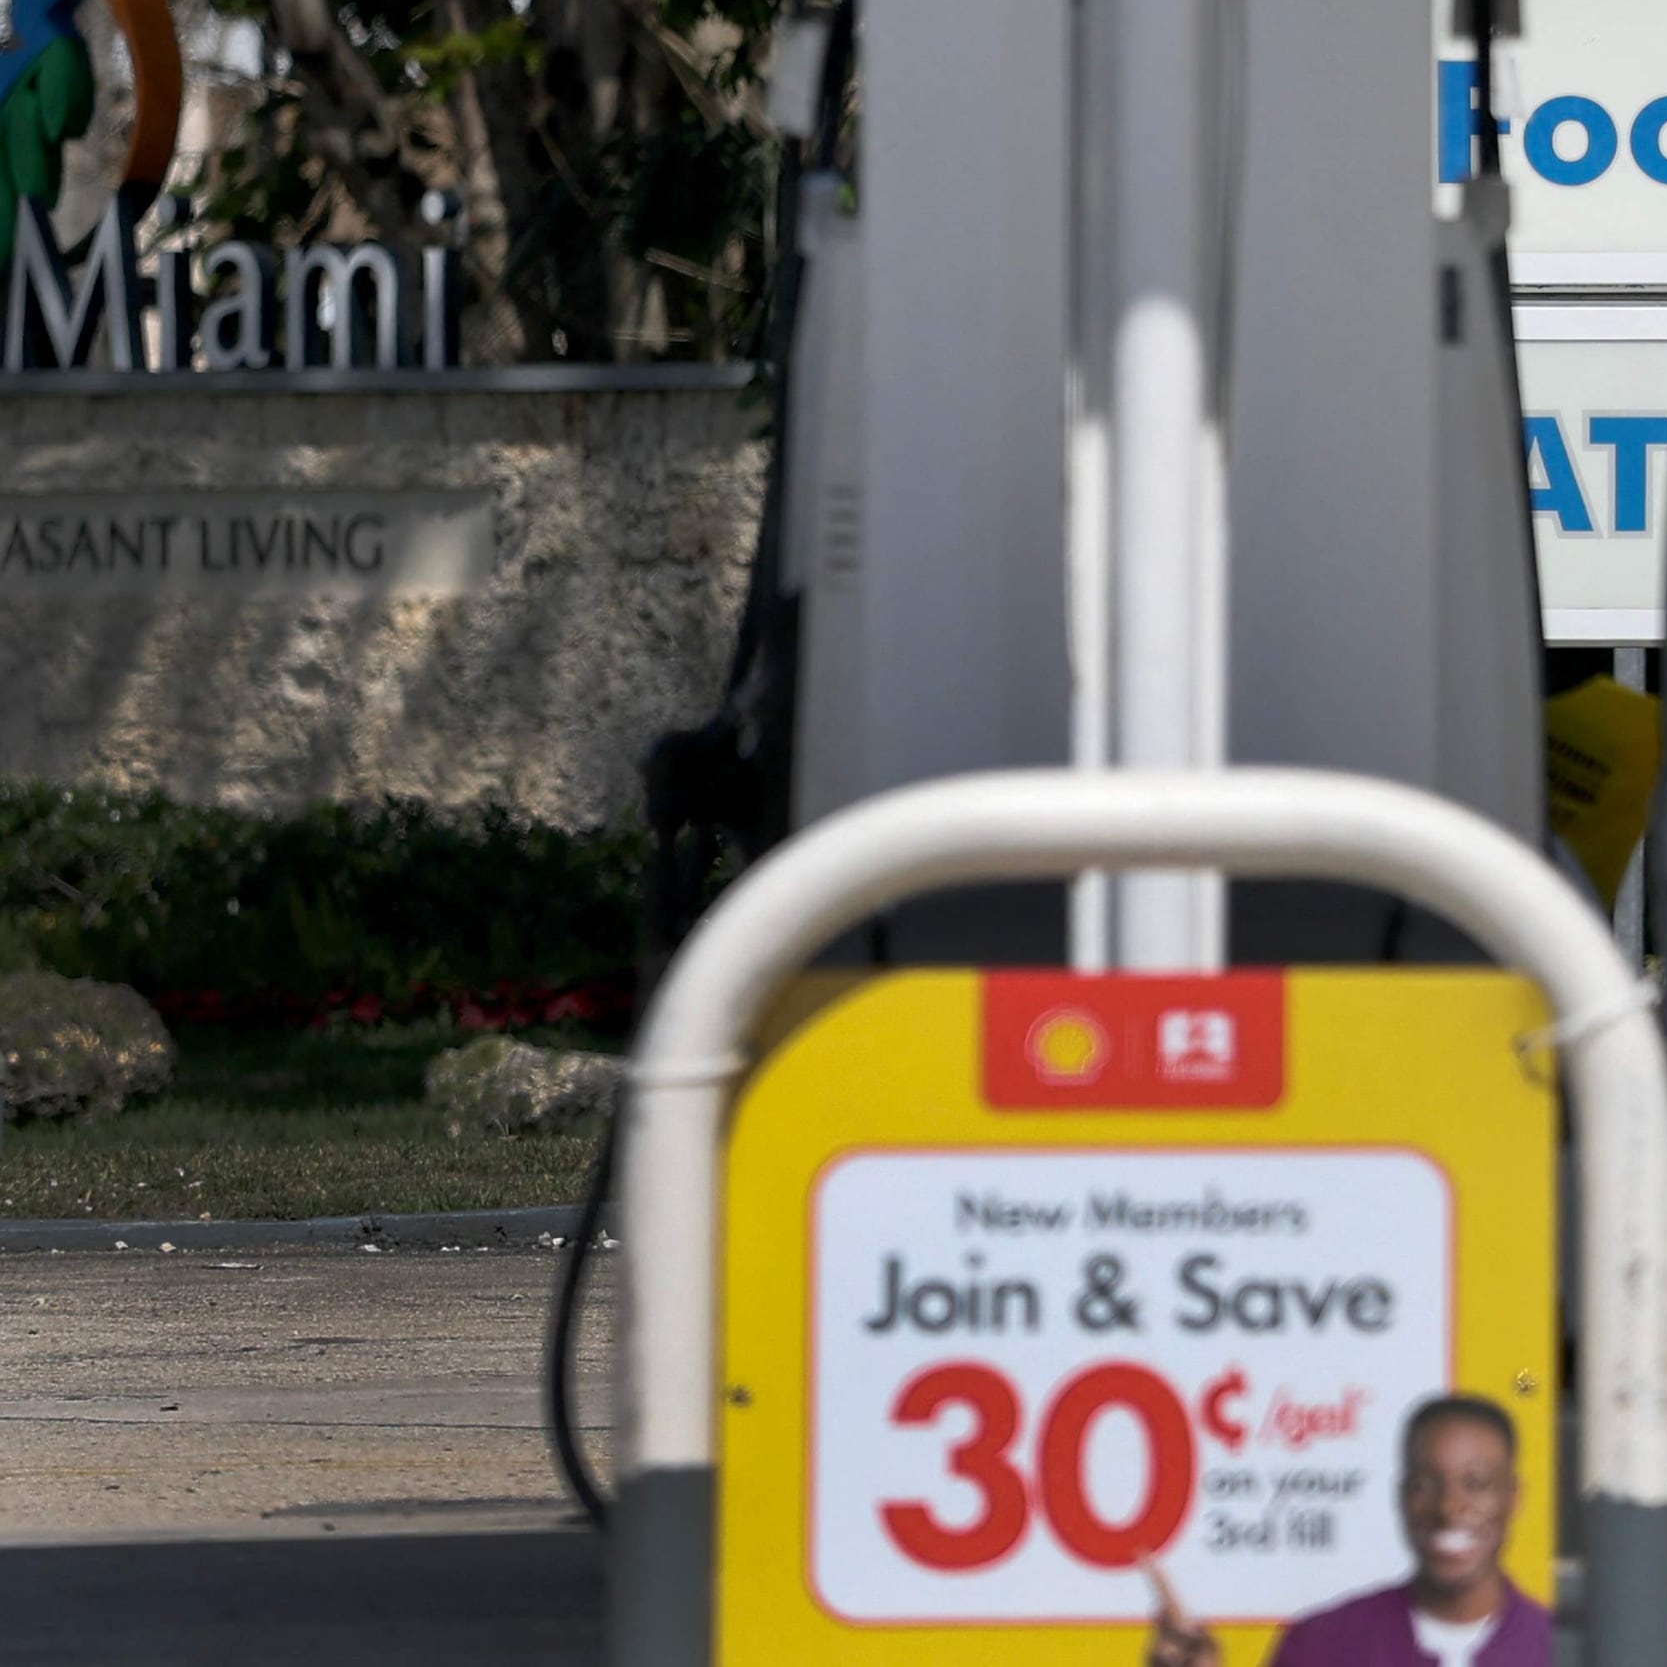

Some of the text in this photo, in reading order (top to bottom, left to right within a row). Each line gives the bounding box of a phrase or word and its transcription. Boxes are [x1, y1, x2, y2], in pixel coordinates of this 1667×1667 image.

[4, 186, 452, 372] Miami
[0, 513, 385, 574] ASANT LIVING
[952, 1190, 1308, 1234] New Members
[864, 1254, 1392, 1335] Join & Save
